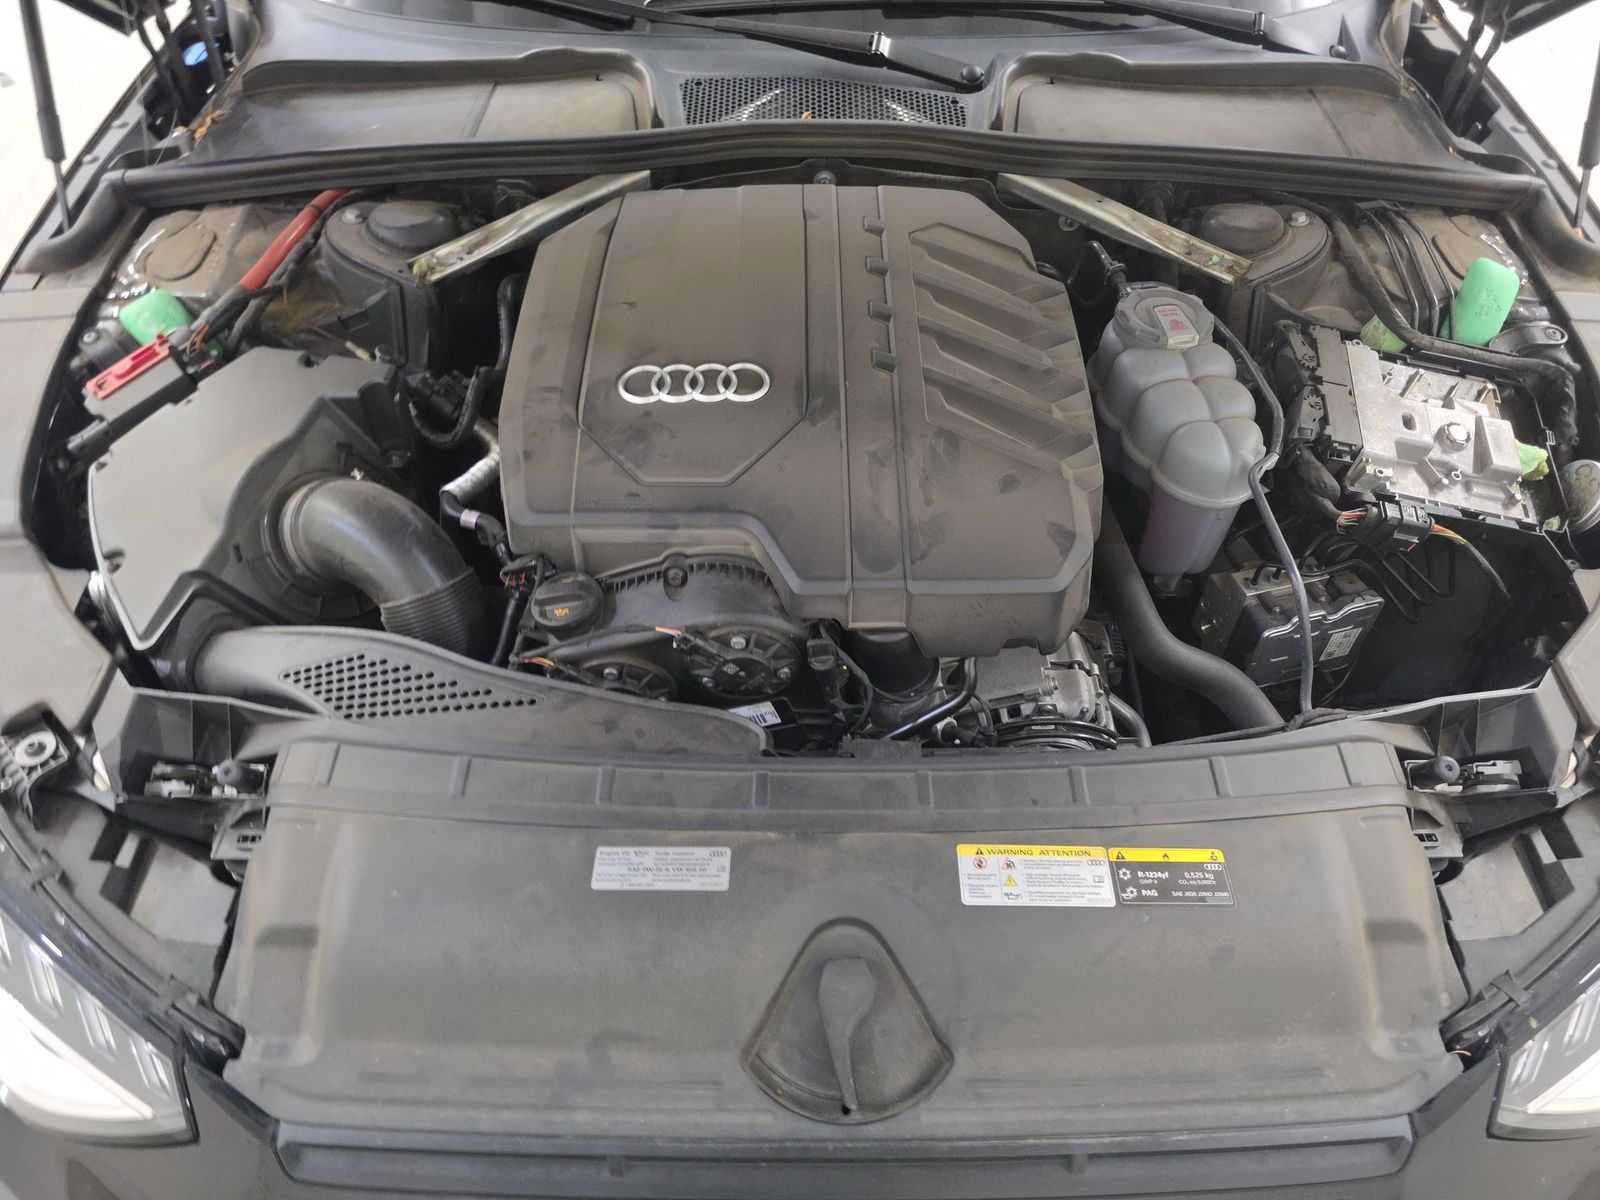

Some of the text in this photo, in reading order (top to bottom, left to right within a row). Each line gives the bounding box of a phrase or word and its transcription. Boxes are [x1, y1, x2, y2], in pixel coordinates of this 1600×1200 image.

[986, 848, 1091, 857] WARNING ATTENTION
[1141, 889, 1159, 897] PAG
